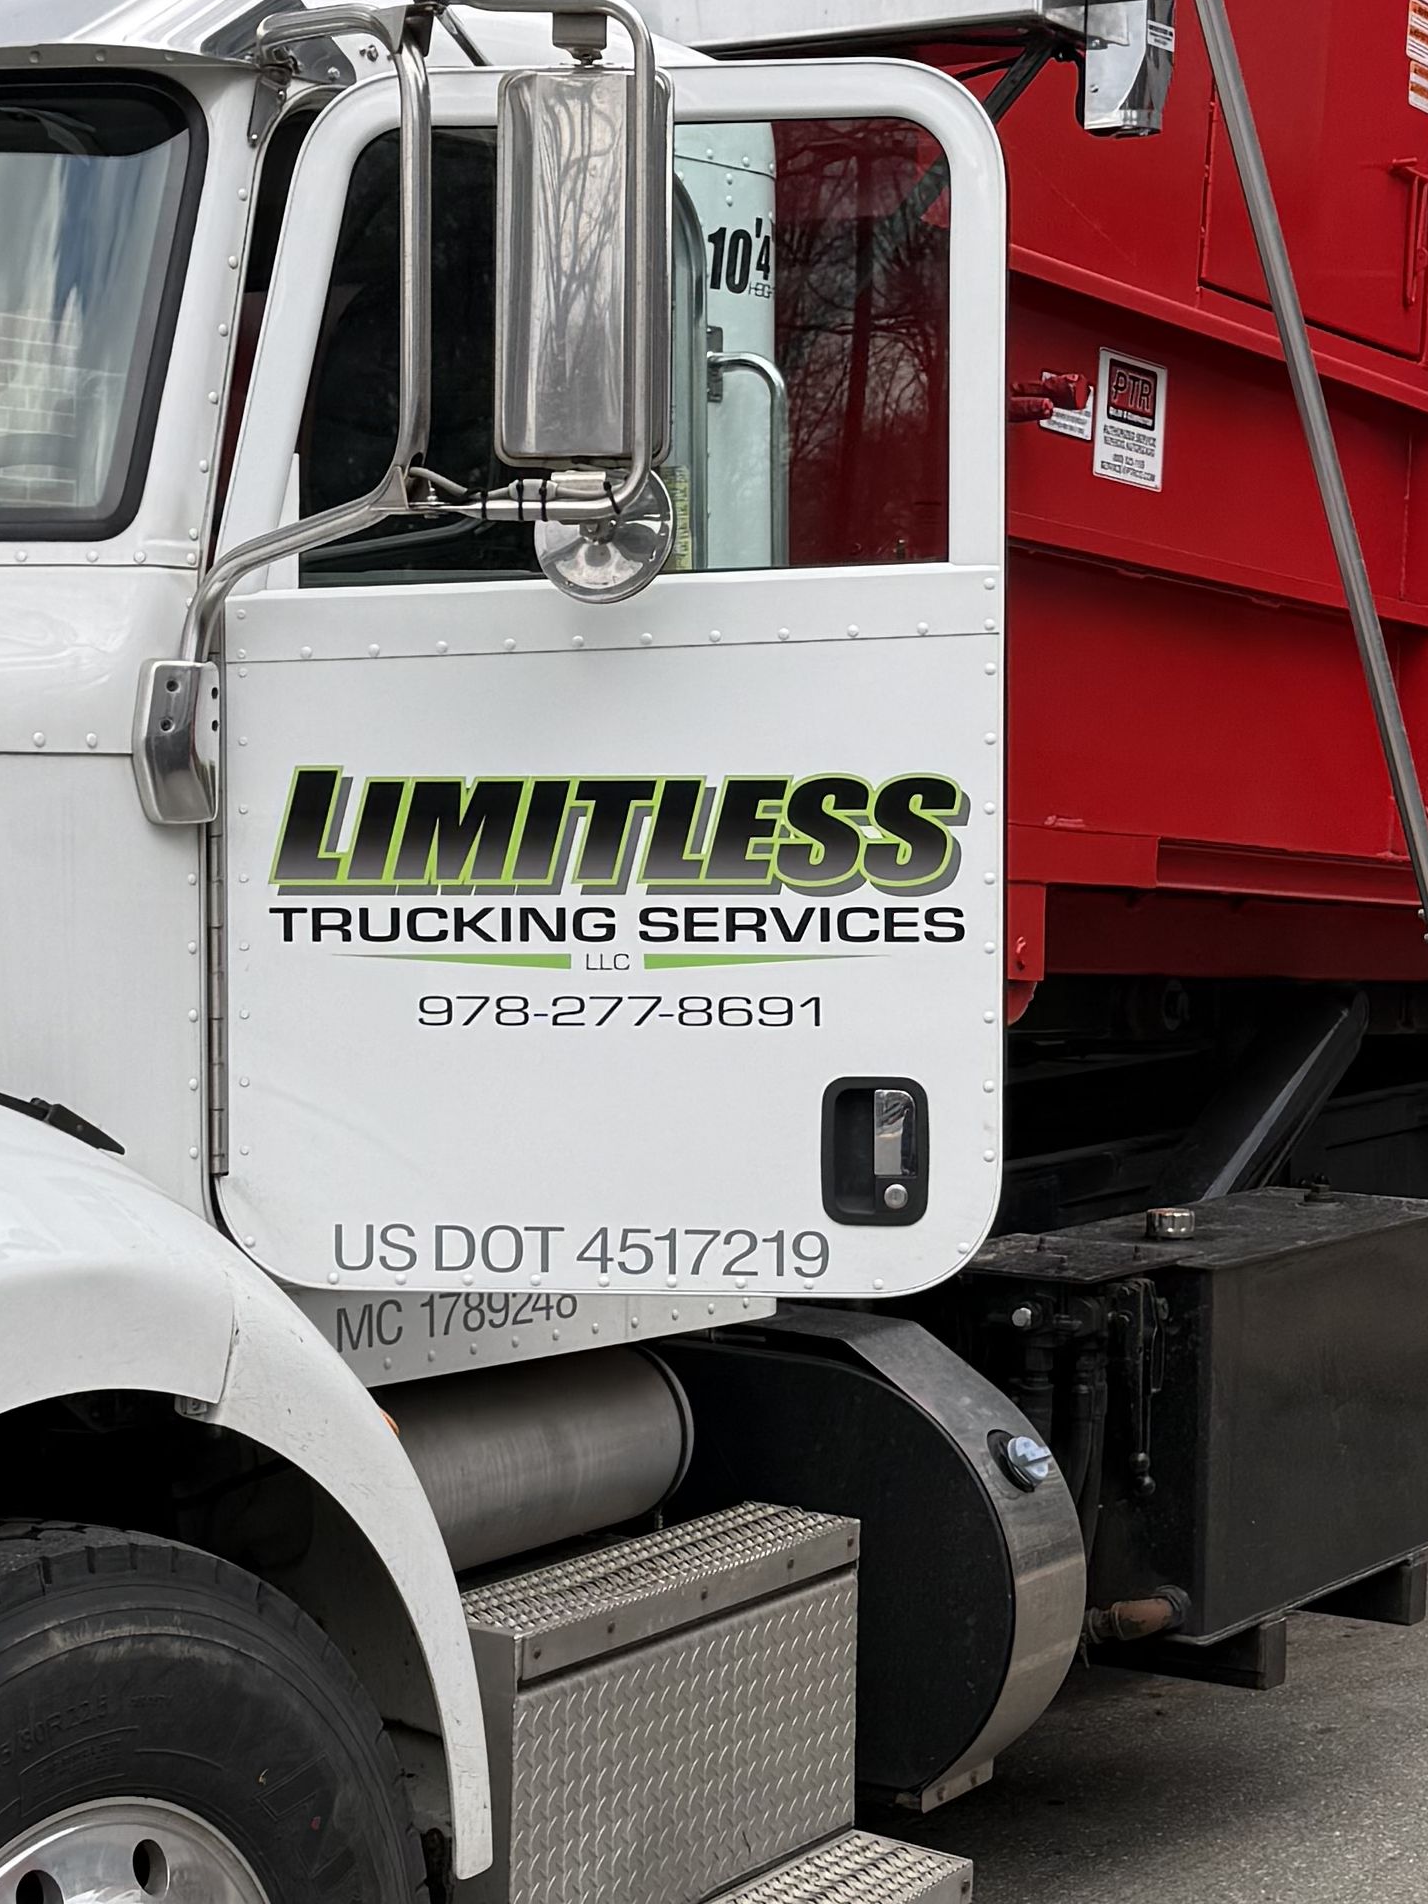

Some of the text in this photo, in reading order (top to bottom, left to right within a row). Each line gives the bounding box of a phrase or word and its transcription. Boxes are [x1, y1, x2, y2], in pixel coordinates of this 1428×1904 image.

[1111, 368, 1152, 413] PTR
[268, 764, 972, 896] LIMITLESS
[269, 906, 966, 944] TRUCKING SERVICES
[584, 953, 631, 972] LLC
[418, 996, 823, 1029] 978-277-8691
[334, 1223, 830, 1279] US DOT 4517219
[336, 1299, 403, 1353] MC
